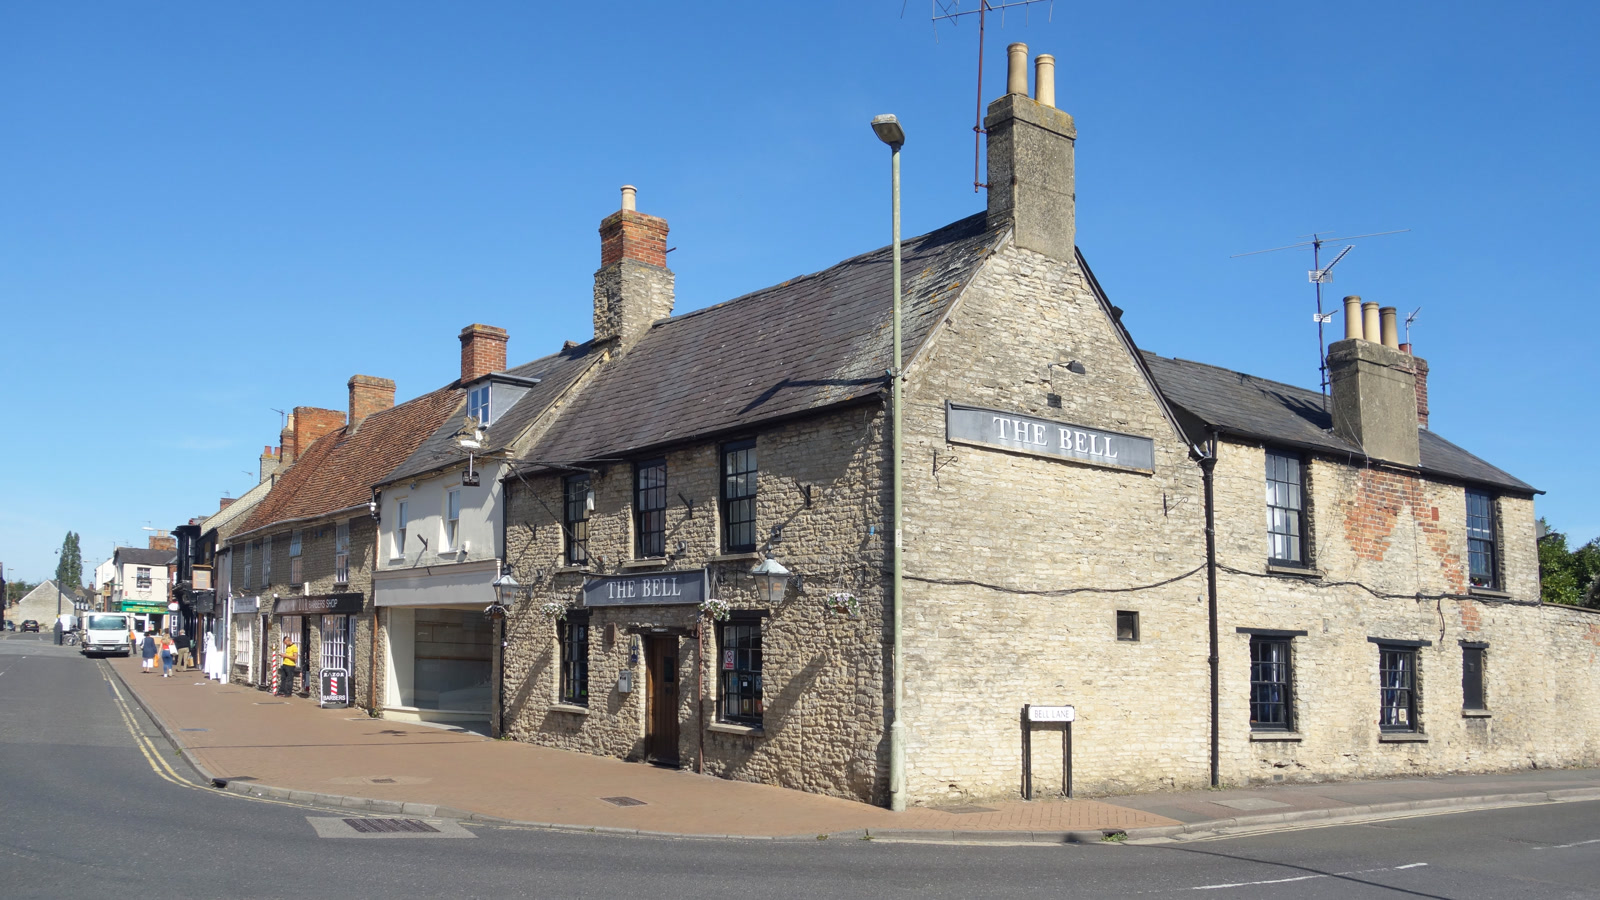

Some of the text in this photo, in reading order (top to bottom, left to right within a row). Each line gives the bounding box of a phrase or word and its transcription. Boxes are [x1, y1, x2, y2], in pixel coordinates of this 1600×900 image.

[993, 416, 1118, 458] THE BELL
[606, 577, 682, 599] THE BELL
[308, 600, 326, 609] BARBERS
[326, 598, 338, 608] SHOP
[1034, 710, 1070, 718] BELL LANE
